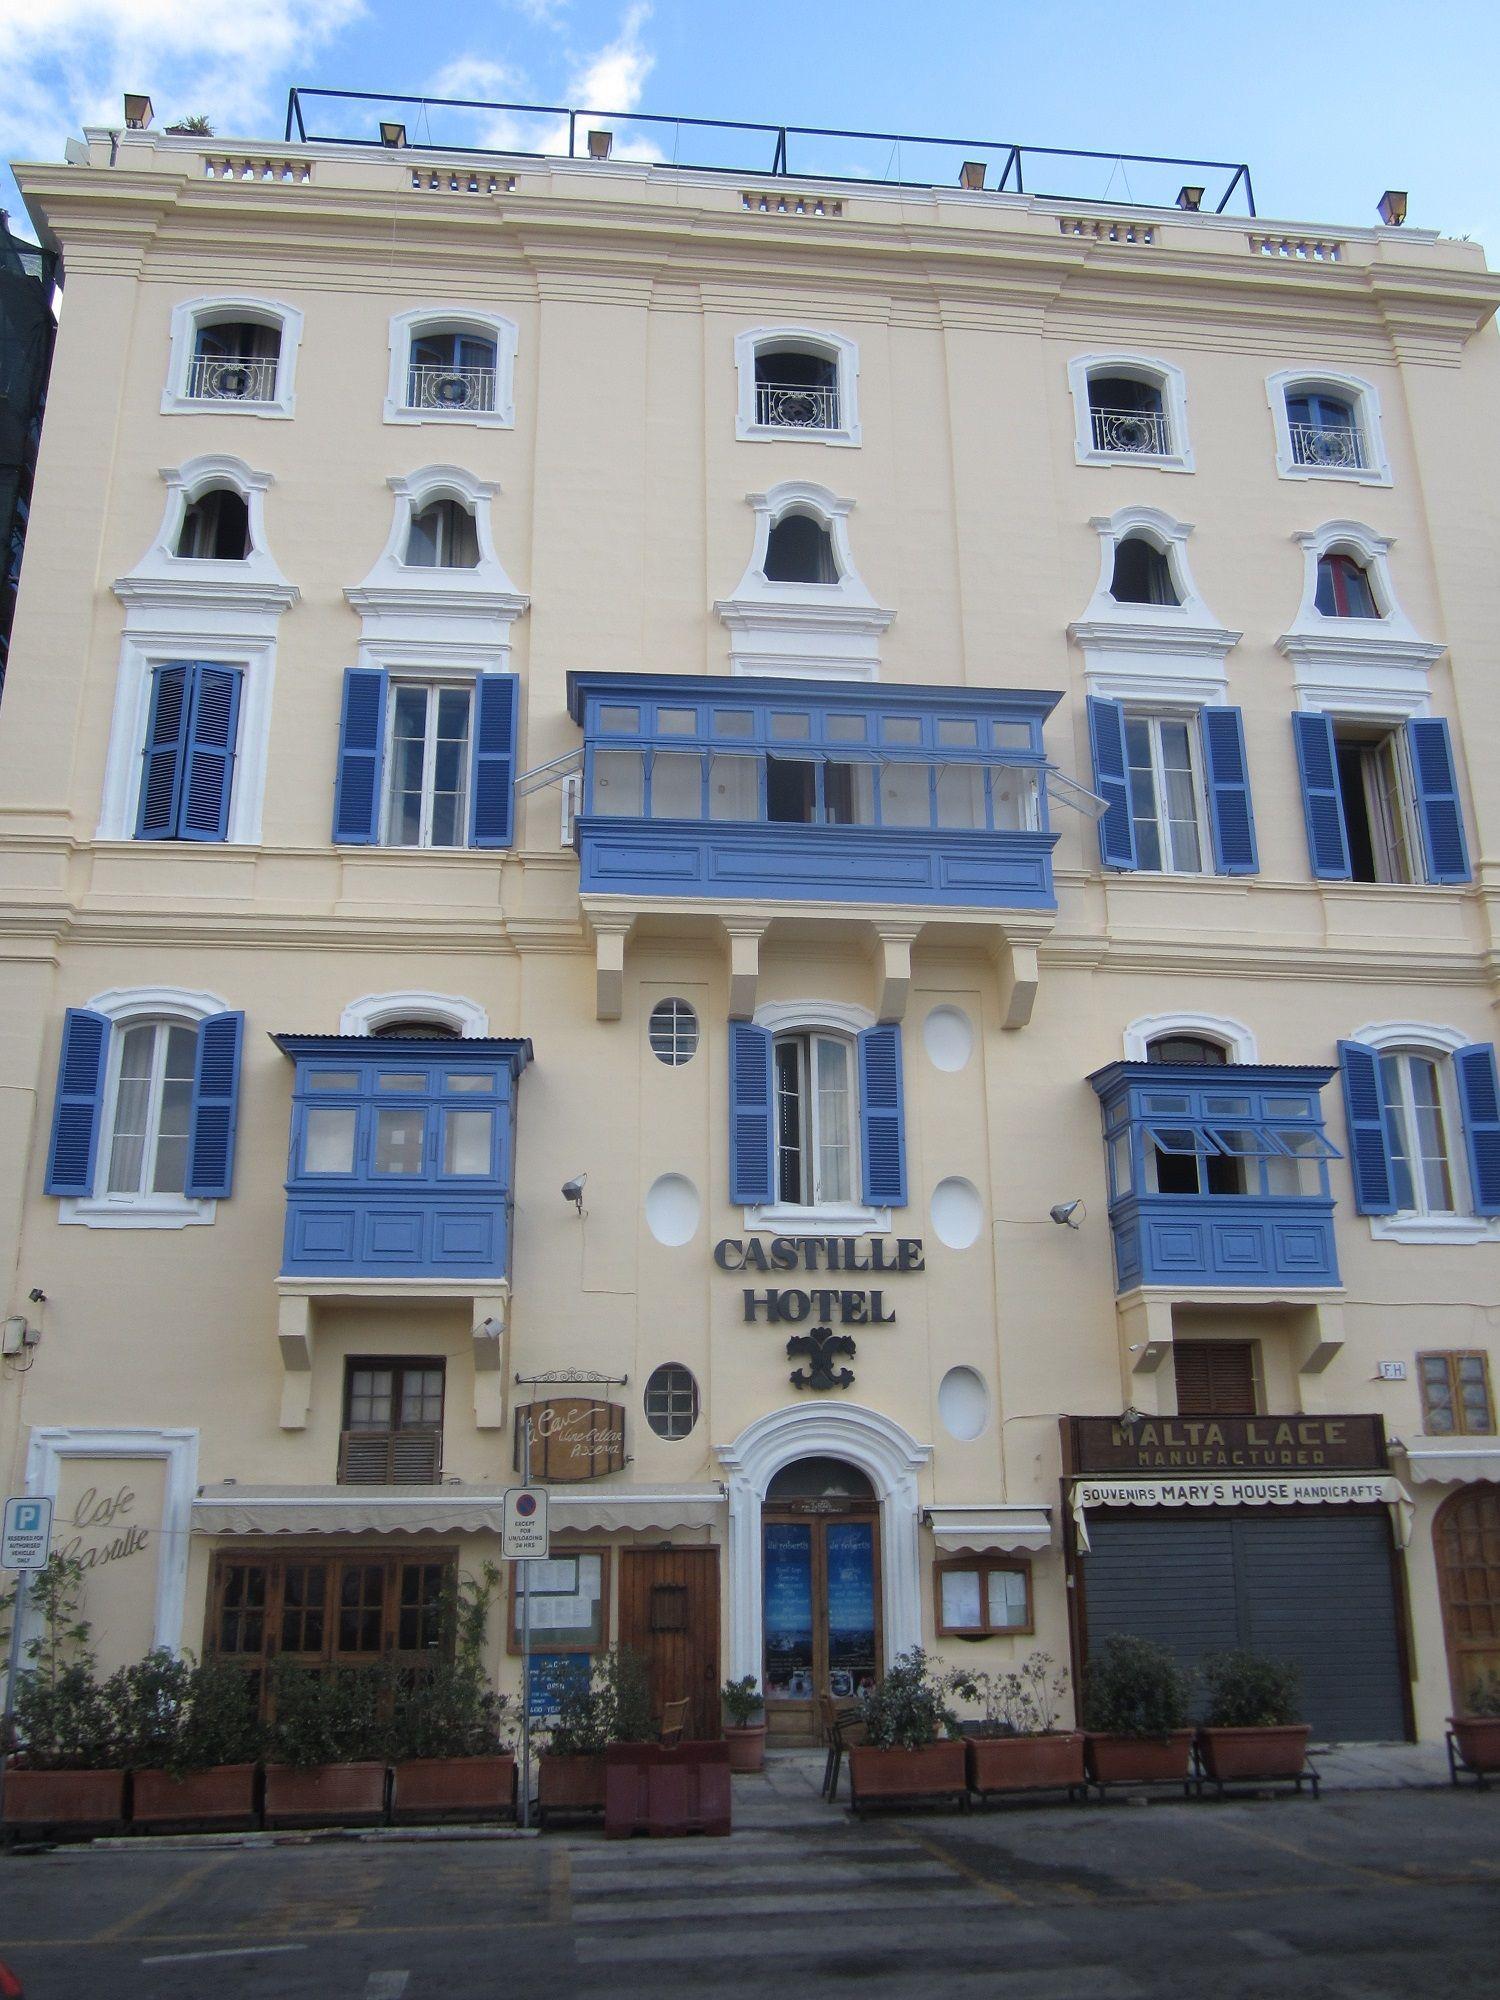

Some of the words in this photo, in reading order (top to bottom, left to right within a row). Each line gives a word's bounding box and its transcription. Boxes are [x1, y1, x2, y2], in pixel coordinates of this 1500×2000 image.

[714, 1237, 925, 1271] CASTILLE
[742, 1288, 896, 1323] HOTEL
[1111, 1422, 1225, 1447] MALTA
[1247, 1422, 1347, 1446] LACE
[72, 1484, 135, 1528] Cafe
[1082, 1487, 1156, 1501] SOUVENIRS
[1231, 1484, 1289, 1499] HOUSE
[1294, 1484, 1383, 1498] HANDICRAFTS
[19, 1506, 36, 1529] P
